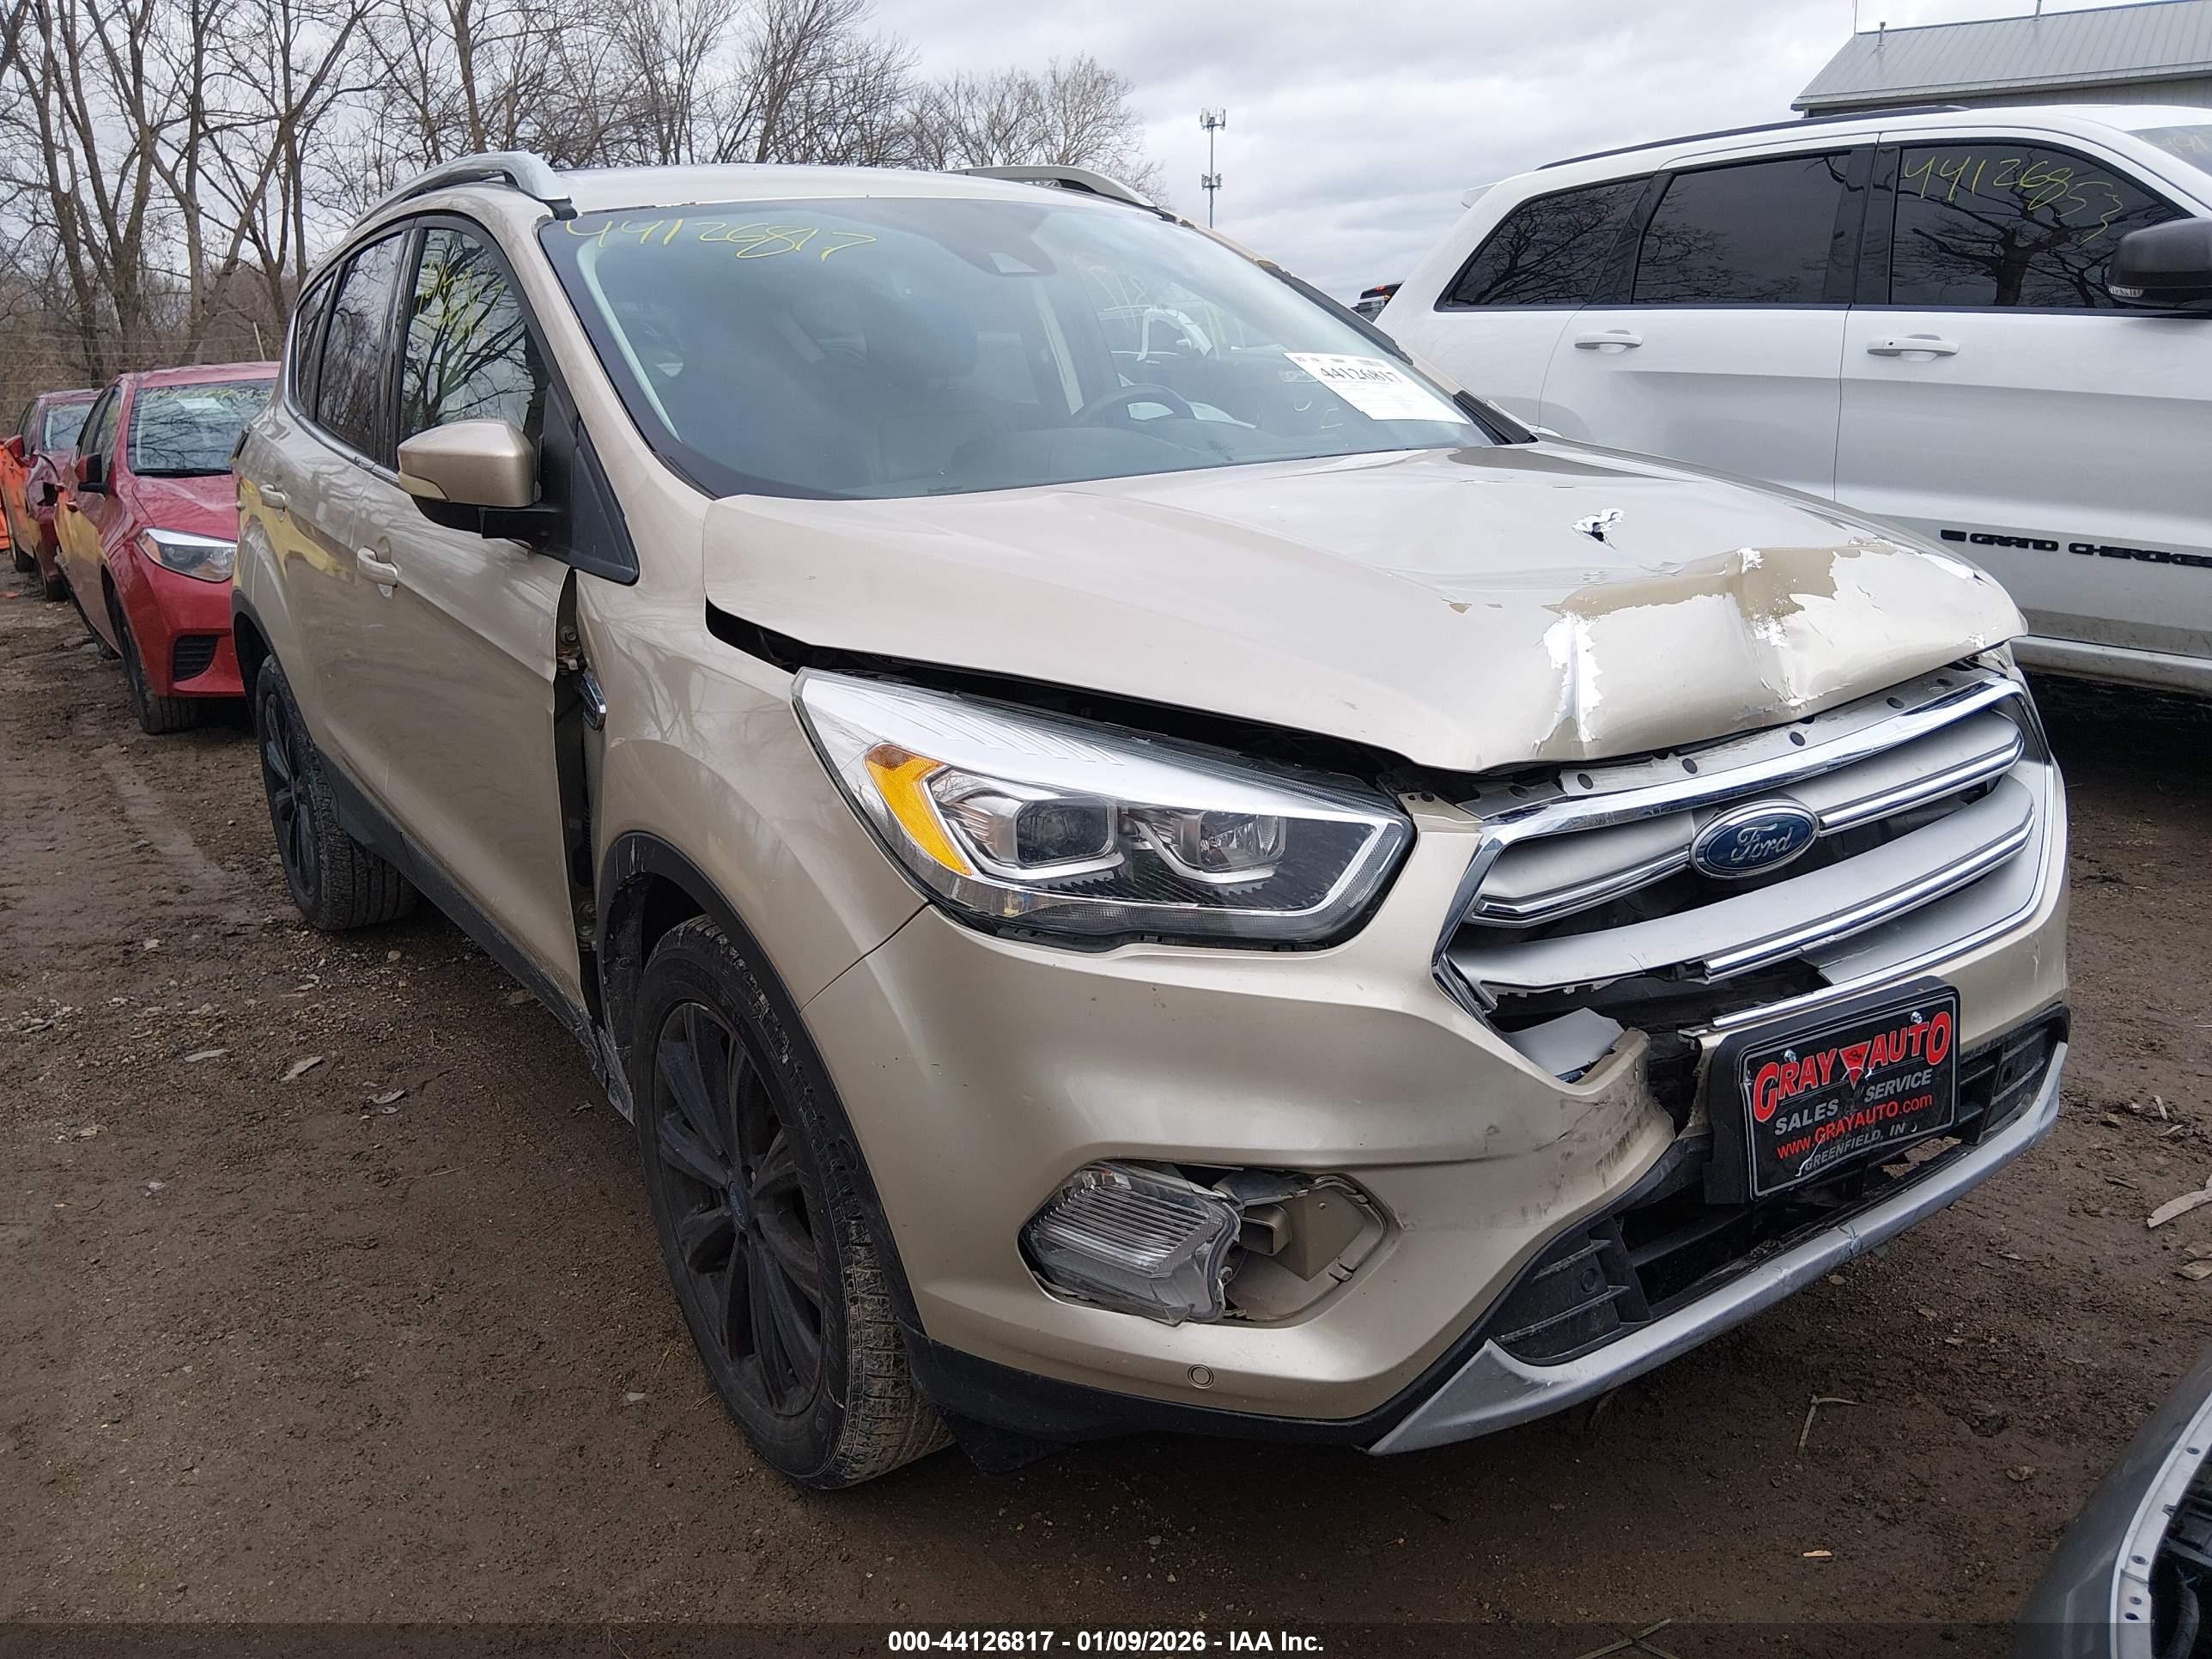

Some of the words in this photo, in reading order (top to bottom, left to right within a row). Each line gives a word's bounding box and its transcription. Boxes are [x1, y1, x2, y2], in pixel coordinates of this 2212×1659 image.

[1904, 155, 2124, 246] 44126853
[565, 219, 878, 261] 44126817
[1970, 532, 2059, 552] GRAND
[1730, 823, 1794, 861] Ford
[1753, 1047, 1838, 1122] GRAY
[1870, 1011, 1952, 1066] AUTO
[1774, 1097, 1839, 1136] SALES
[1863, 1068, 1934, 1104] SERVICE
[1777, 1093, 1934, 1160] www.GRAYAUTO.com
[1889, 1121, 1906, 1139] IN
